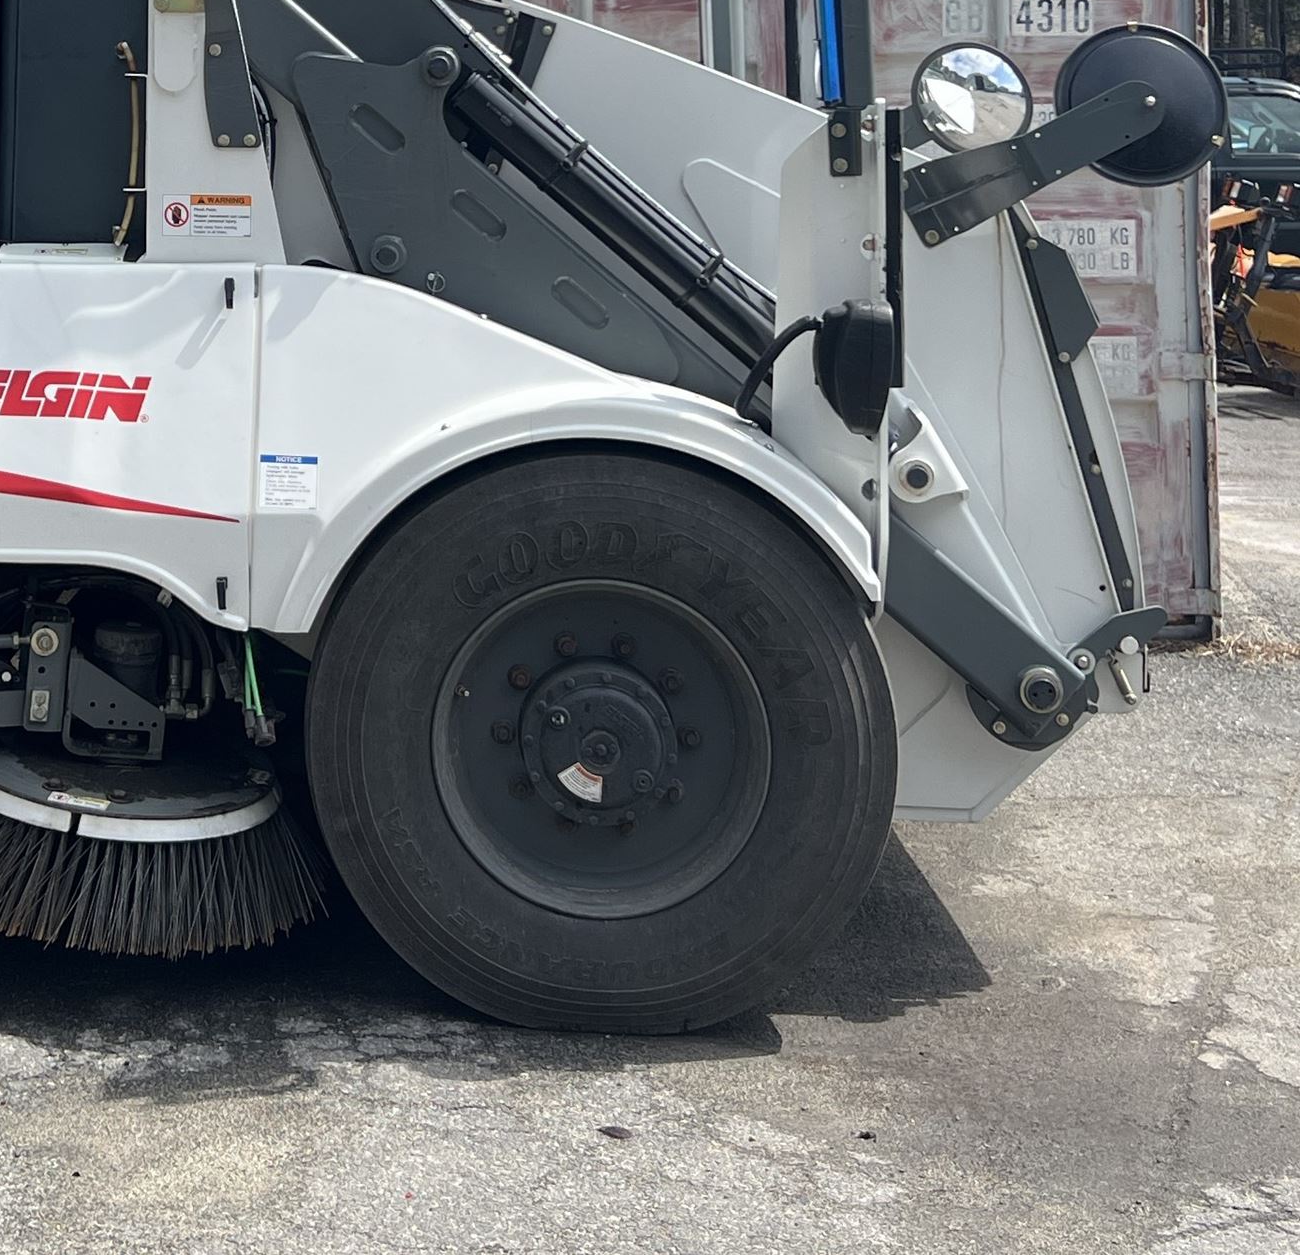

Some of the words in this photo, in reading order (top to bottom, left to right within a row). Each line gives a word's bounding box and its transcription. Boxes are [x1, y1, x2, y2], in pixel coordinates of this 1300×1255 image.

[1068, 227, 1096, 245] 780
[1110, 227, 1130, 245] KG
[1111, 252, 1130, 271] LB
[1111, 344, 1131, 361] KG
[276, 455, 302, 463] NOTICE
[453, 520, 834, 746] GOODYEAR
